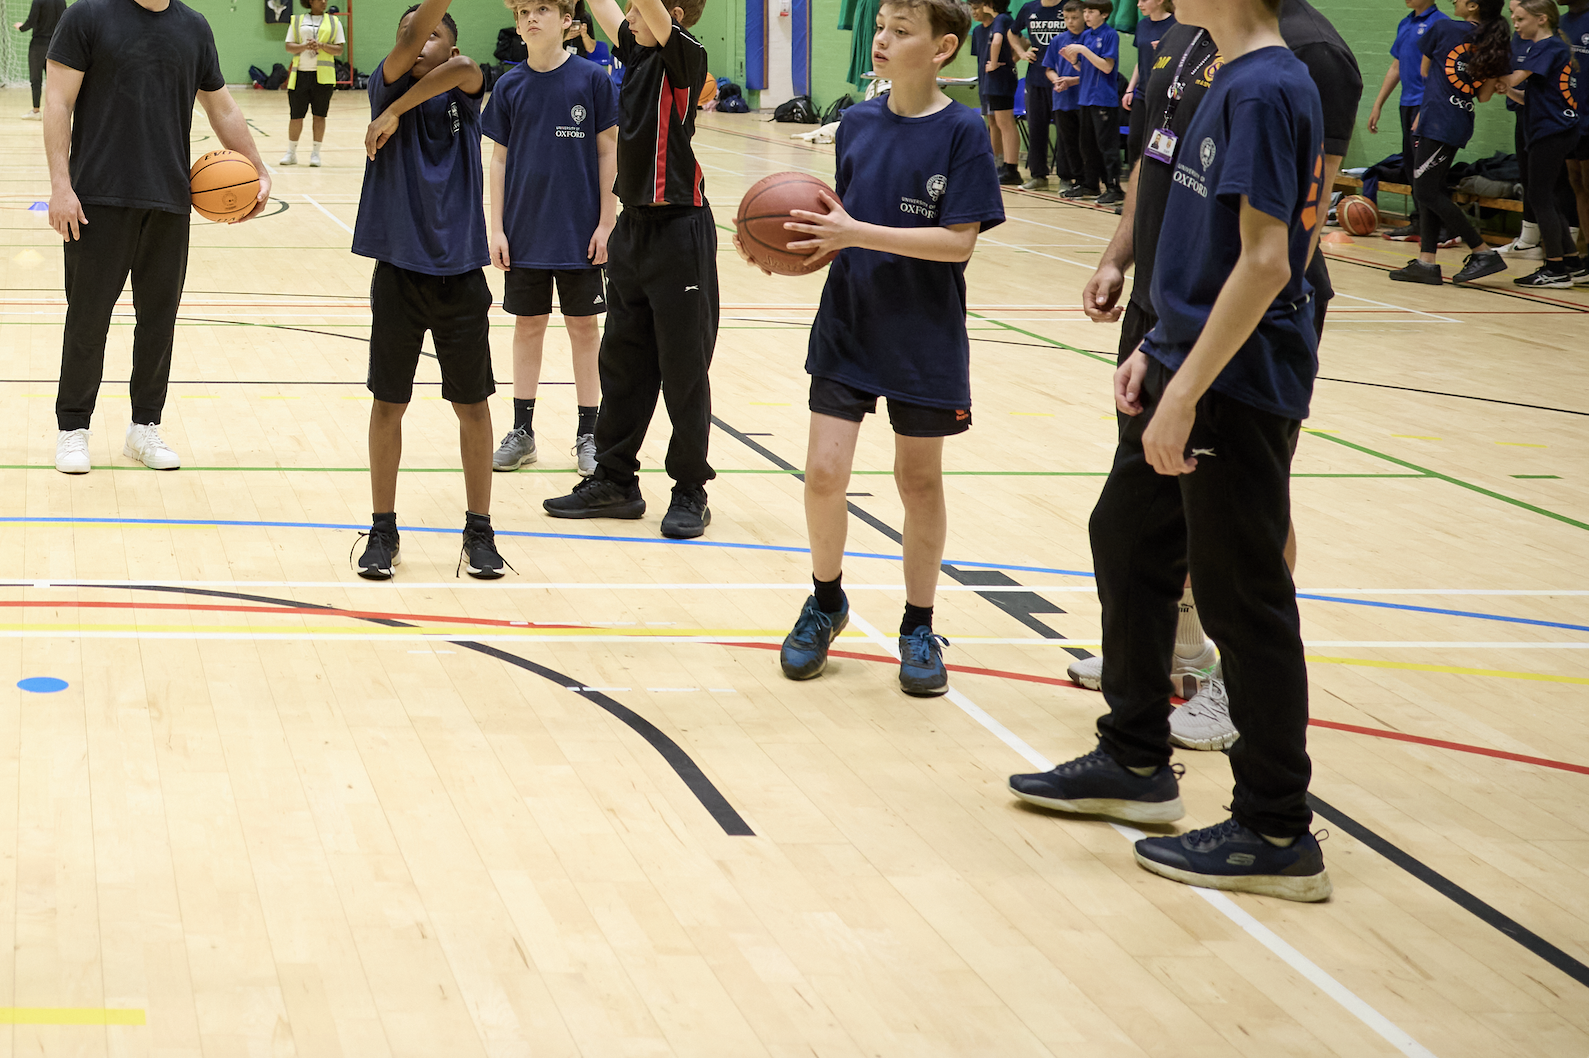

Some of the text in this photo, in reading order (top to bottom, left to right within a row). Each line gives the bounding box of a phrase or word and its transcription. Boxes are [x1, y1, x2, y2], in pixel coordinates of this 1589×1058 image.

[1029, 20, 1068, 30] OXFORD
[555, 130, 586, 139] OXFORD
[1173, 170, 1208, 198] OXFORD
